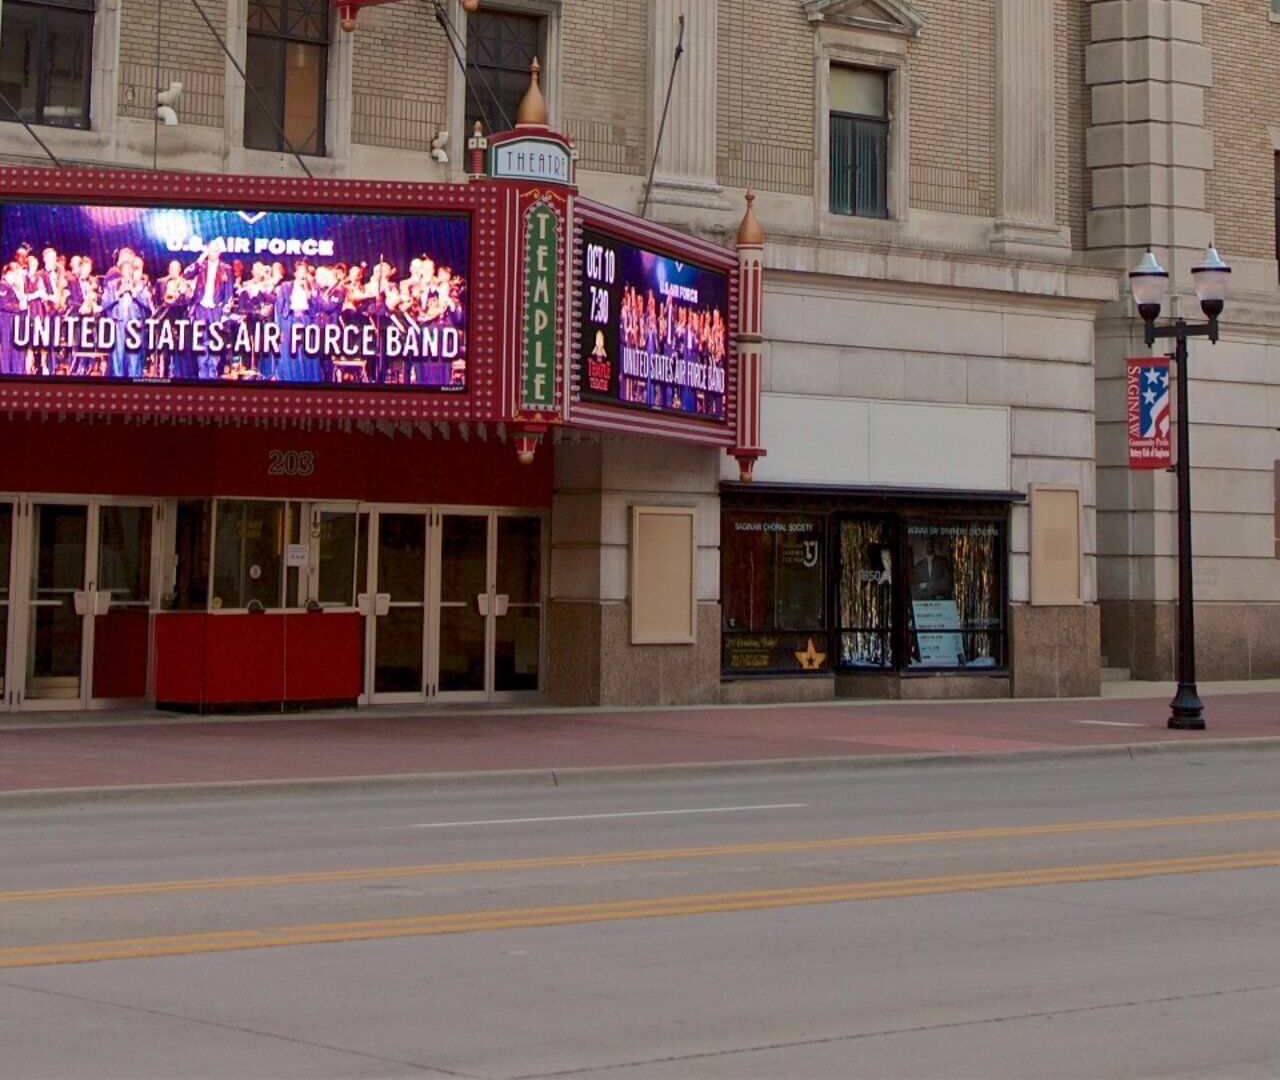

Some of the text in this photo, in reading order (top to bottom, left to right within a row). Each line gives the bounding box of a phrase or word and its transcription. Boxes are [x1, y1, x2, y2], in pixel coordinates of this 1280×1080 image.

[506, 151, 566, 177] THEATRE
[214, 236, 251, 253] AIR
[254, 238, 335, 257] FORCE
[586, 242, 616, 285] OCT 10
[533, 212, 550, 401] TEMPLE
[590, 285, 609, 324] 7:30
[13, 315, 459, 359] UNITED STATES AIR FORCE BAND
[623, 346, 649, 377] UNITED
[650, 353, 674, 383] STATES
[687, 361, 707, 389] FORCE
[1127, 366, 1141, 437] SAGINAW
[267, 450, 315, 476] 203
